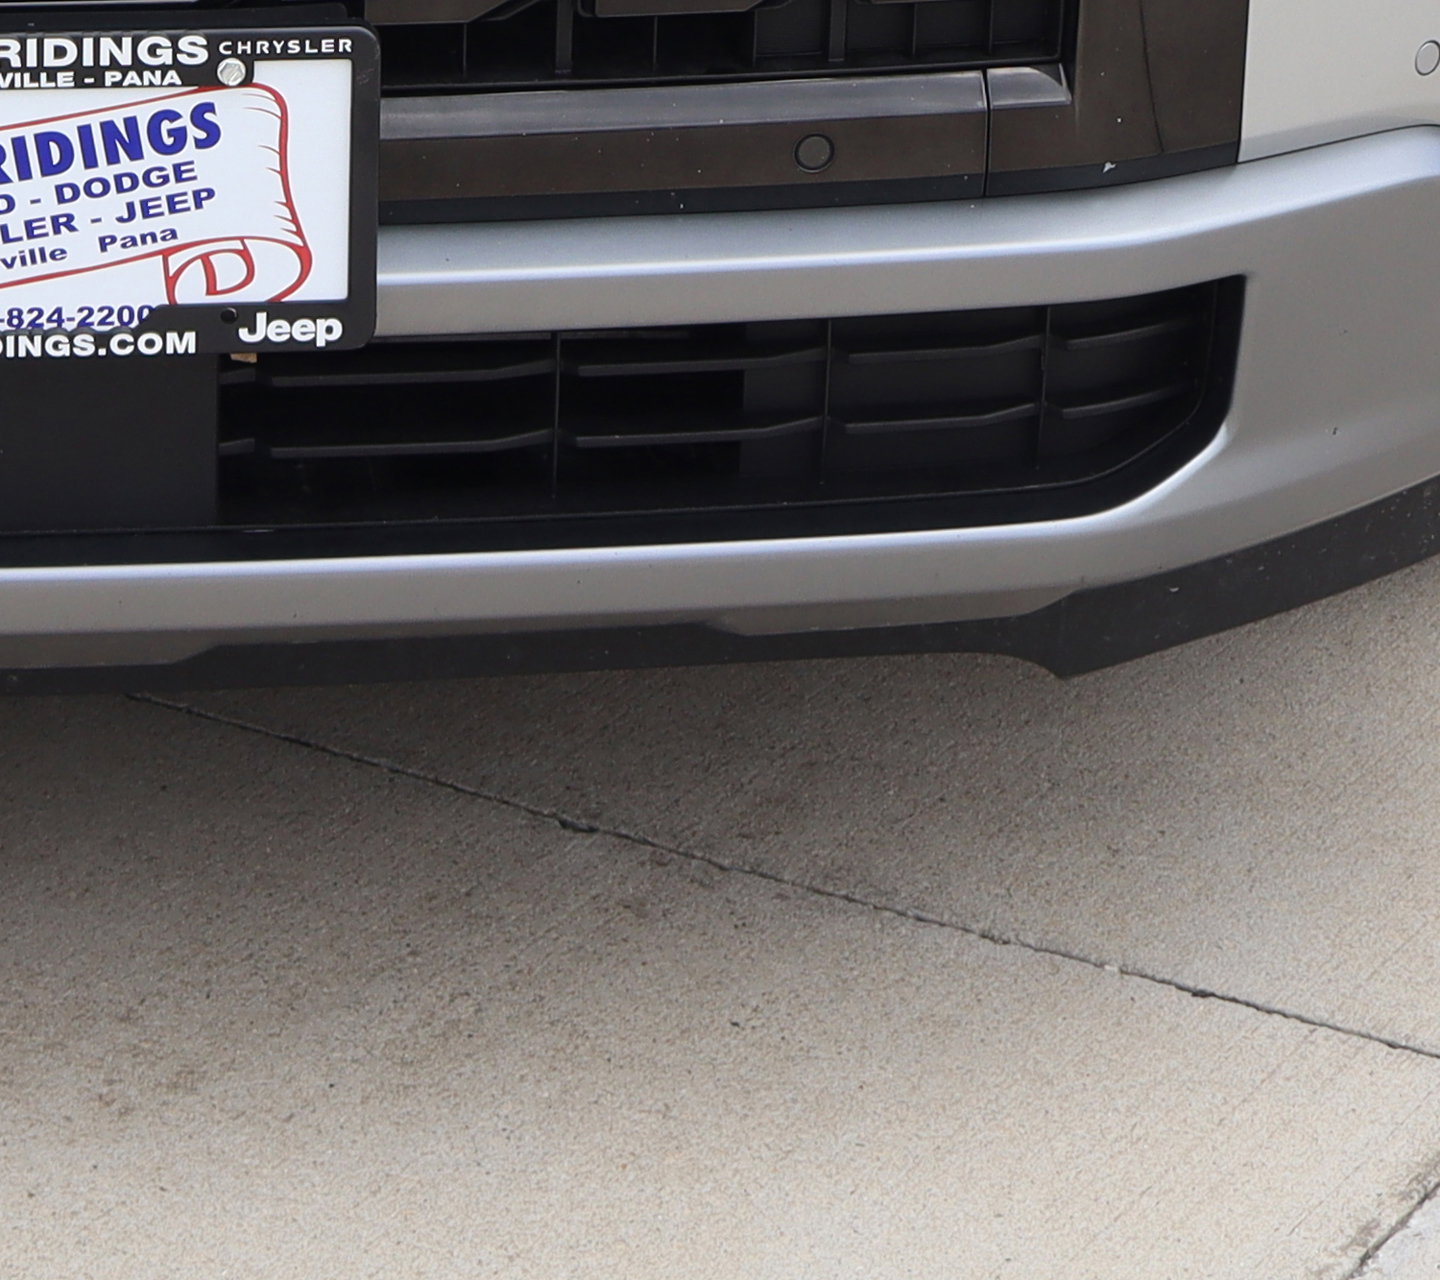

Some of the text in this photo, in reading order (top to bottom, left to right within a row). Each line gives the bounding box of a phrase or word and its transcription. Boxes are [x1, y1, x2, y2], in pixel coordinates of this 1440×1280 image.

[218, 38, 353, 56] CHRYSLER
[104, 70, 183, 88] PANA
[54, 160, 199, 205] DODGE
[114, 187, 217, 224] JEEP
[98, 227, 179, 253] Pana
[237, 311, 344, 348] Jeep
